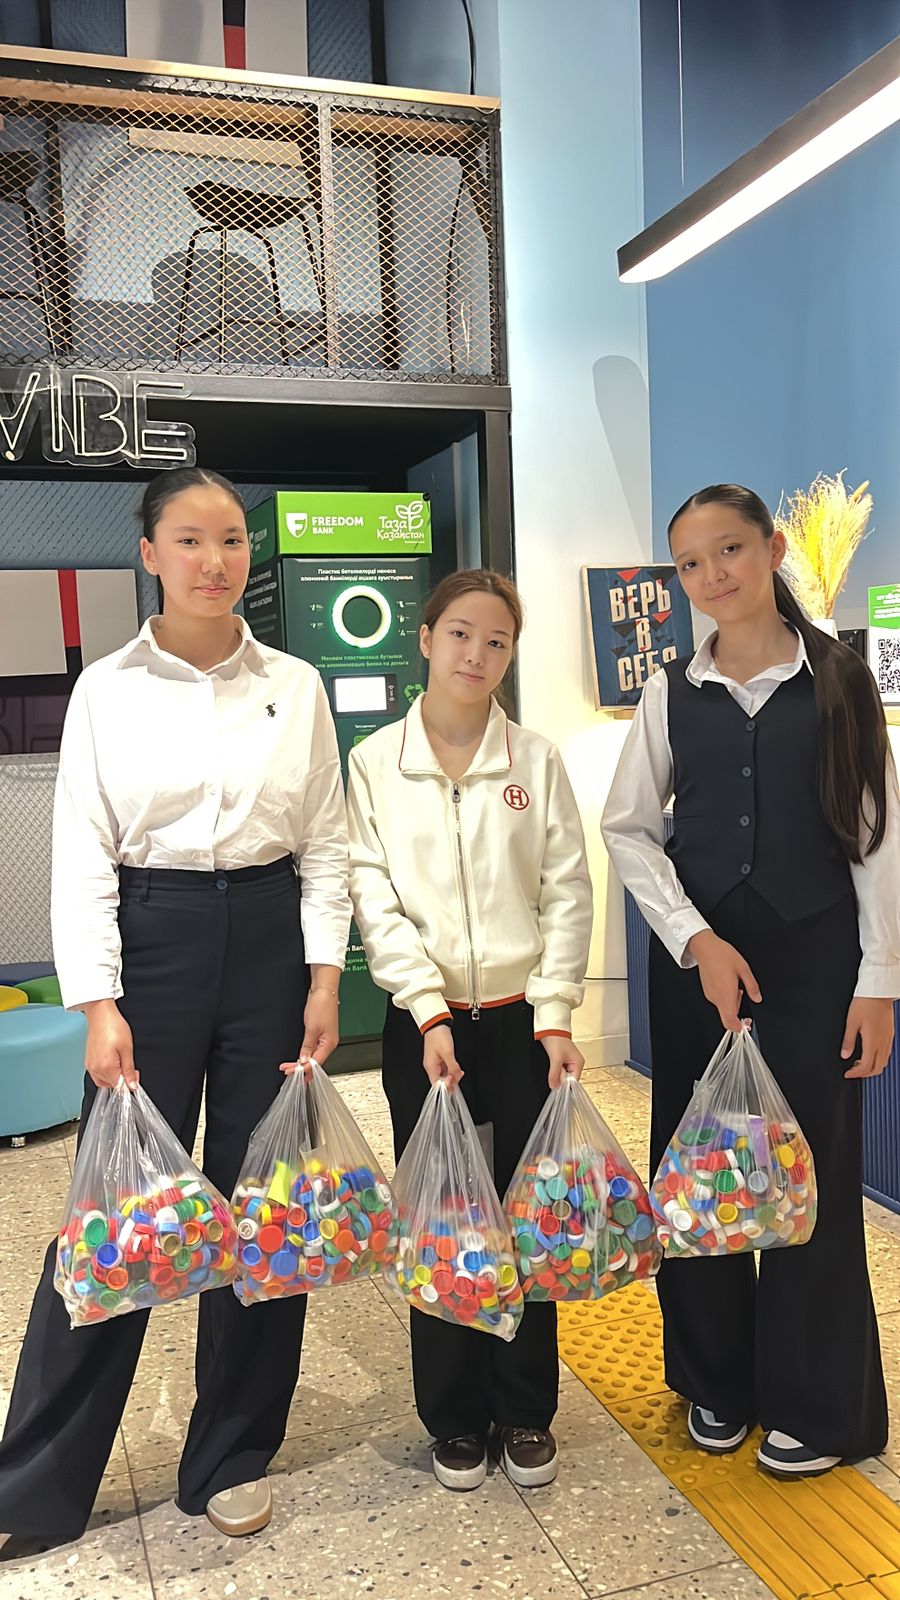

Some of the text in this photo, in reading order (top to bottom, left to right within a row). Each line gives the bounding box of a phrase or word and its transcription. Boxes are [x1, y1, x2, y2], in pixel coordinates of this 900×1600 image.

[312, 516, 364, 526] FREEDOM
[378, 516, 407, 531] Таза
[312, 527, 334, 535] BANK
[376, 529, 425, 541] Қазақстан
[609, 579, 672, 623] ВЕРЬ
[635, 617, 652, 653] В
[508, 788, 525, 806] H
